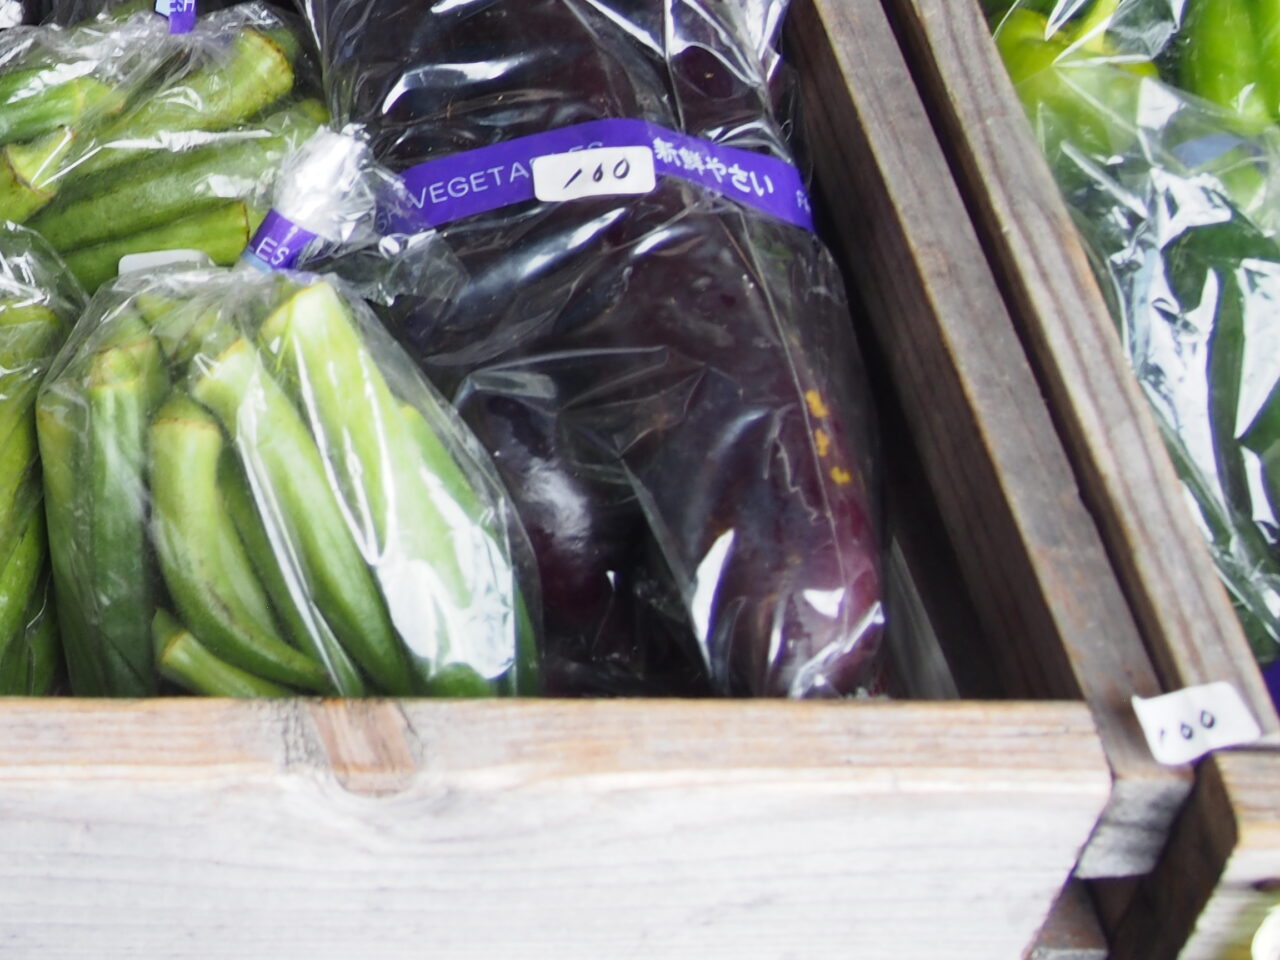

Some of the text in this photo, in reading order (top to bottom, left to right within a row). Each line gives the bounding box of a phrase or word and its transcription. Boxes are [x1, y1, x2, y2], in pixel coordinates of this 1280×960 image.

[408, 158, 536, 209] VEGETA
[653, 137, 774, 197] 新鮮やさい
